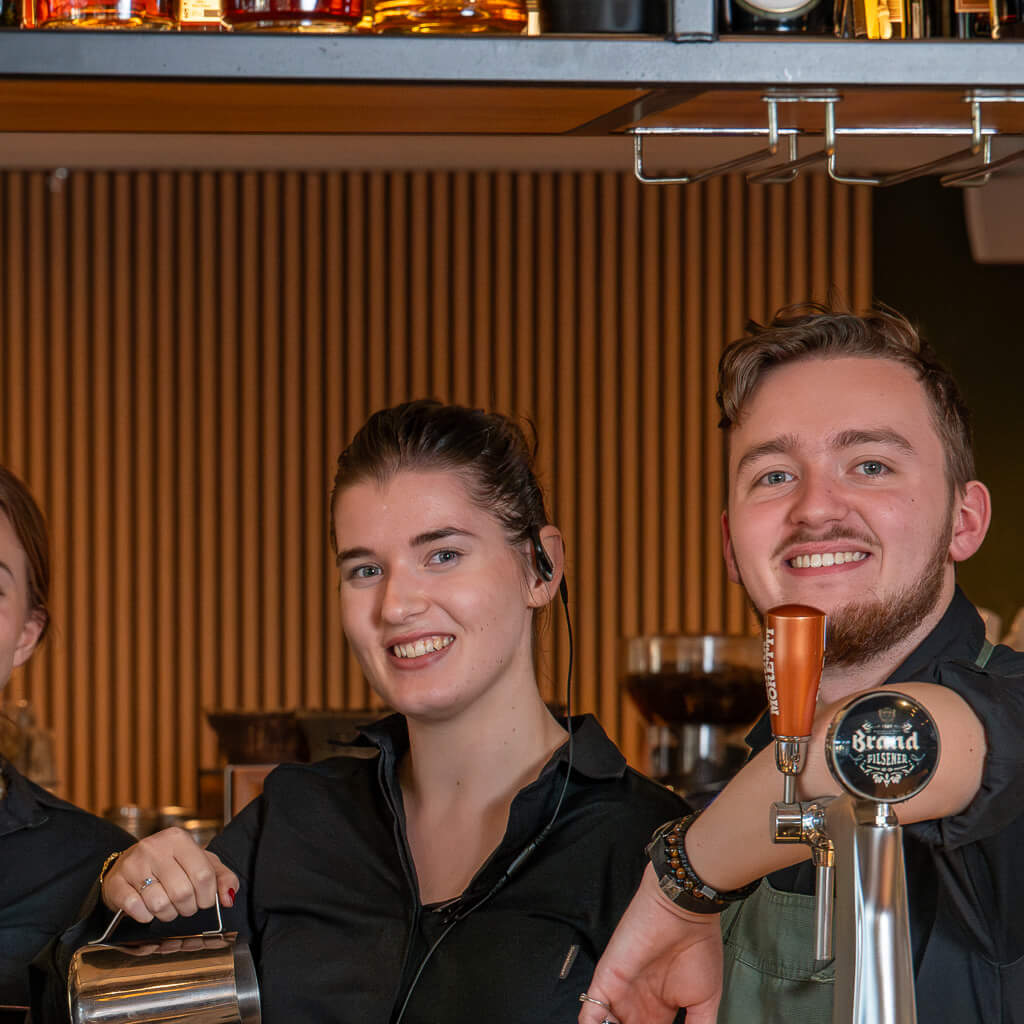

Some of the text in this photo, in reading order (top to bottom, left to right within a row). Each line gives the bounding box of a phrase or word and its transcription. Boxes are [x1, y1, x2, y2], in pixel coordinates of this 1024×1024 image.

[763, 627, 780, 716] MORETTI
[852, 729, 920, 753] Brand
[867, 752, 908, 766] PILSENER
